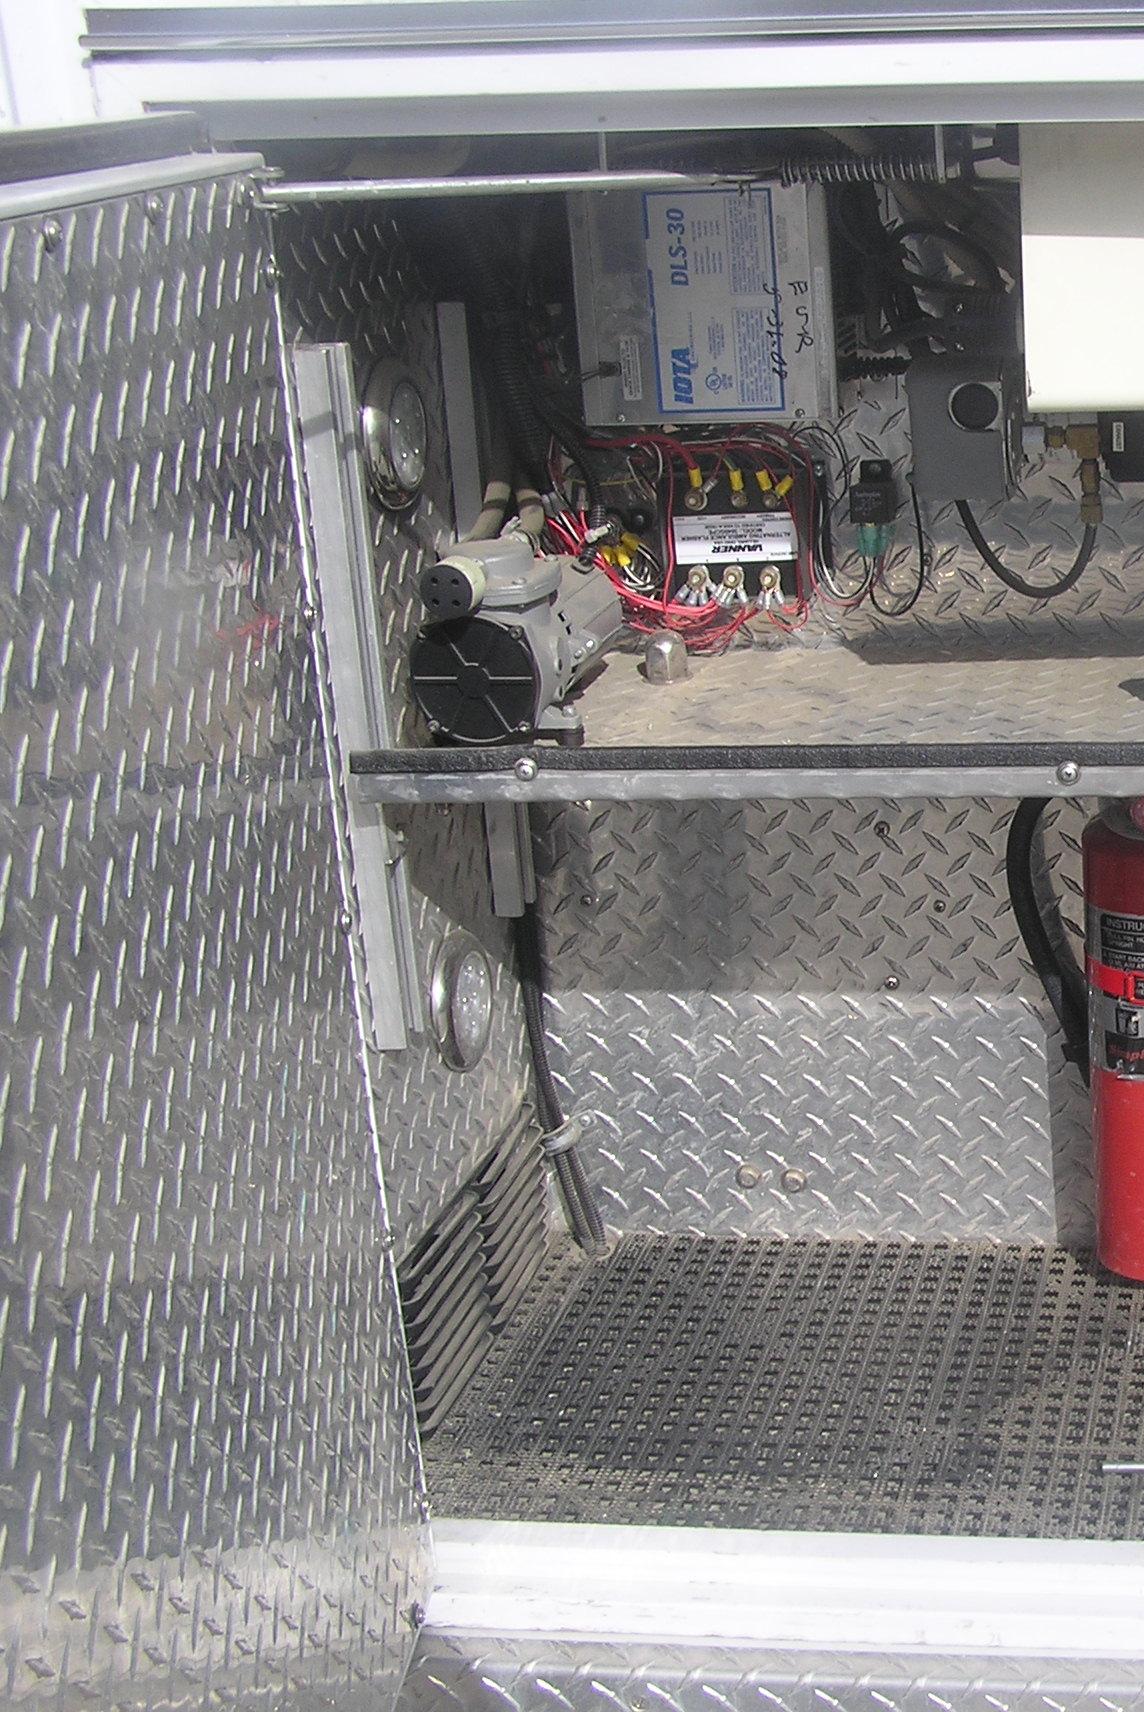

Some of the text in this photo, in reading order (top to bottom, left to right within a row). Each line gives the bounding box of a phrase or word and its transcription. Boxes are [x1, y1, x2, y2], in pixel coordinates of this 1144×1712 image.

[665, 208, 690, 287] DLS-30
[670, 346, 698, 405] IOTA
[711, 544, 763, 554] VANNER
